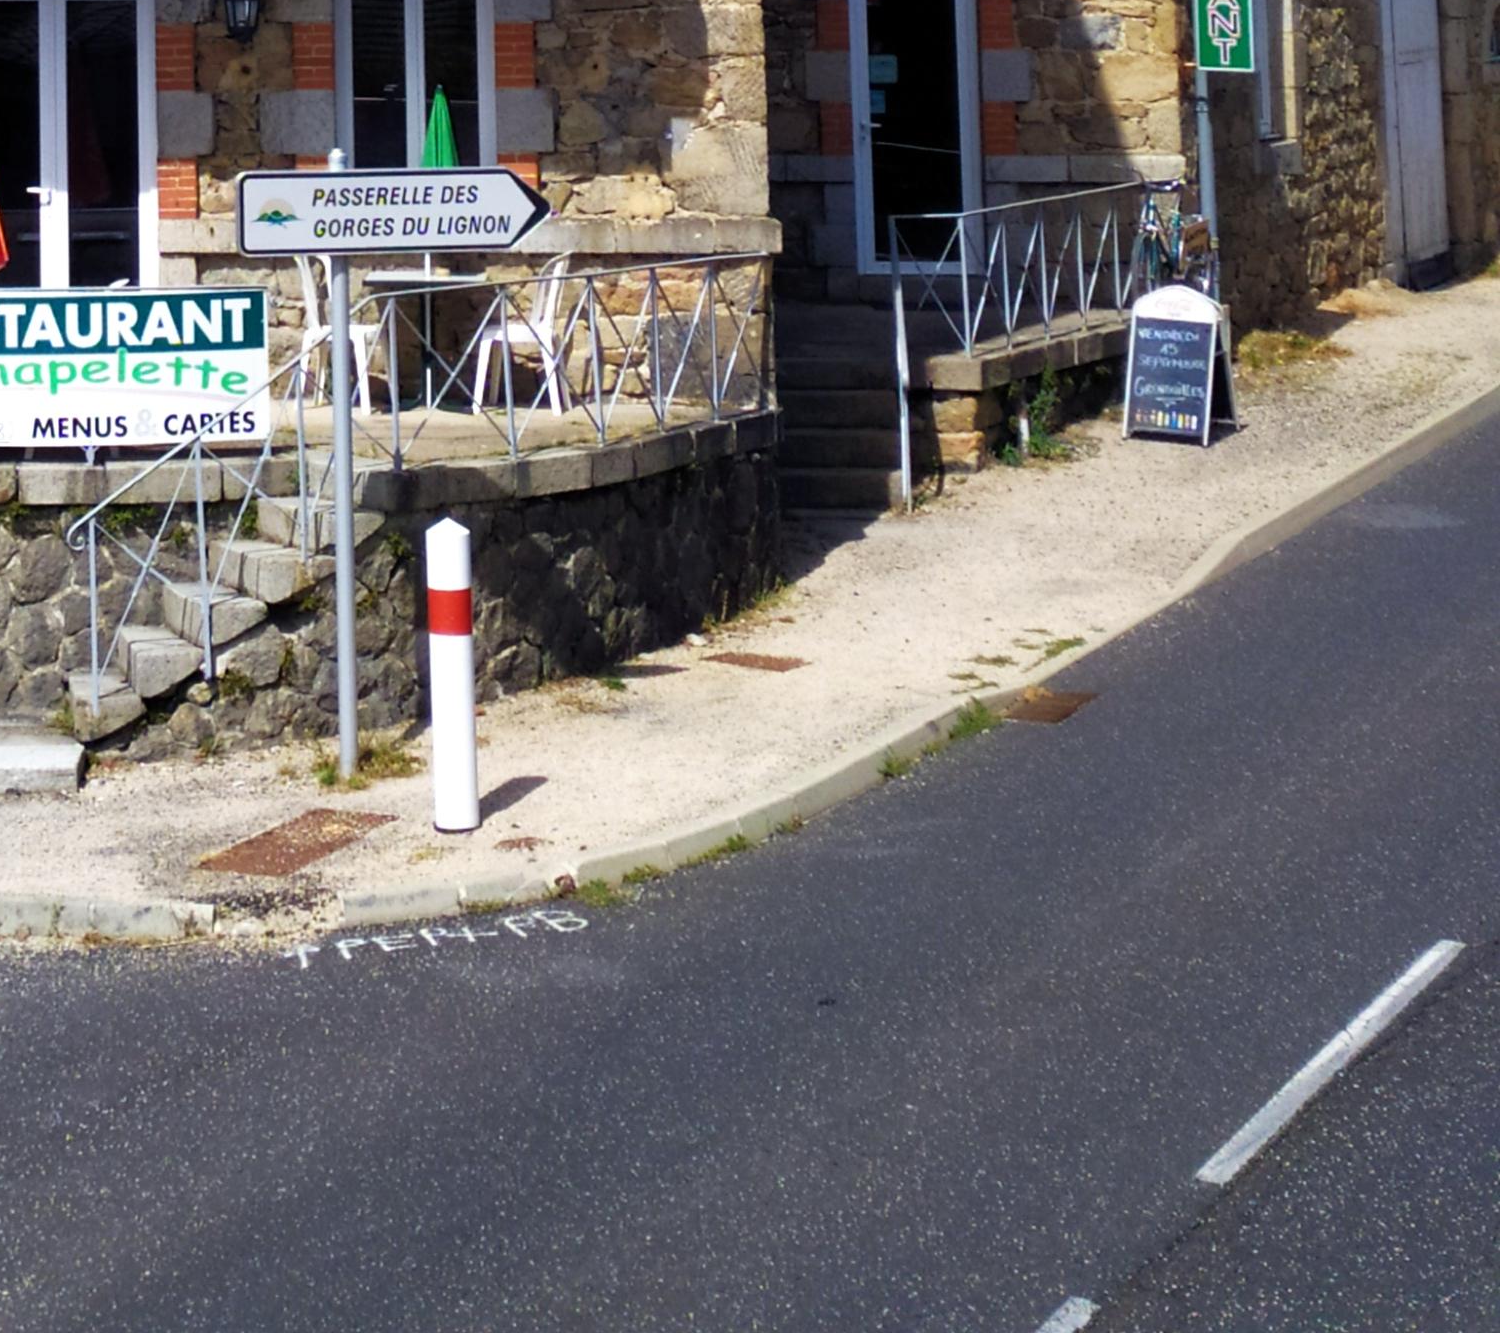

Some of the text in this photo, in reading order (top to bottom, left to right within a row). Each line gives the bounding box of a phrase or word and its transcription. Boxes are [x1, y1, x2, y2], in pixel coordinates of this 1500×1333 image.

[311, 184, 479, 208] PASSERELLE DES
[313, 214, 511, 238] GORGES DU LIGNON
[32, 416, 128, 439] MENUS
[164, 411, 256, 436] CARTES
